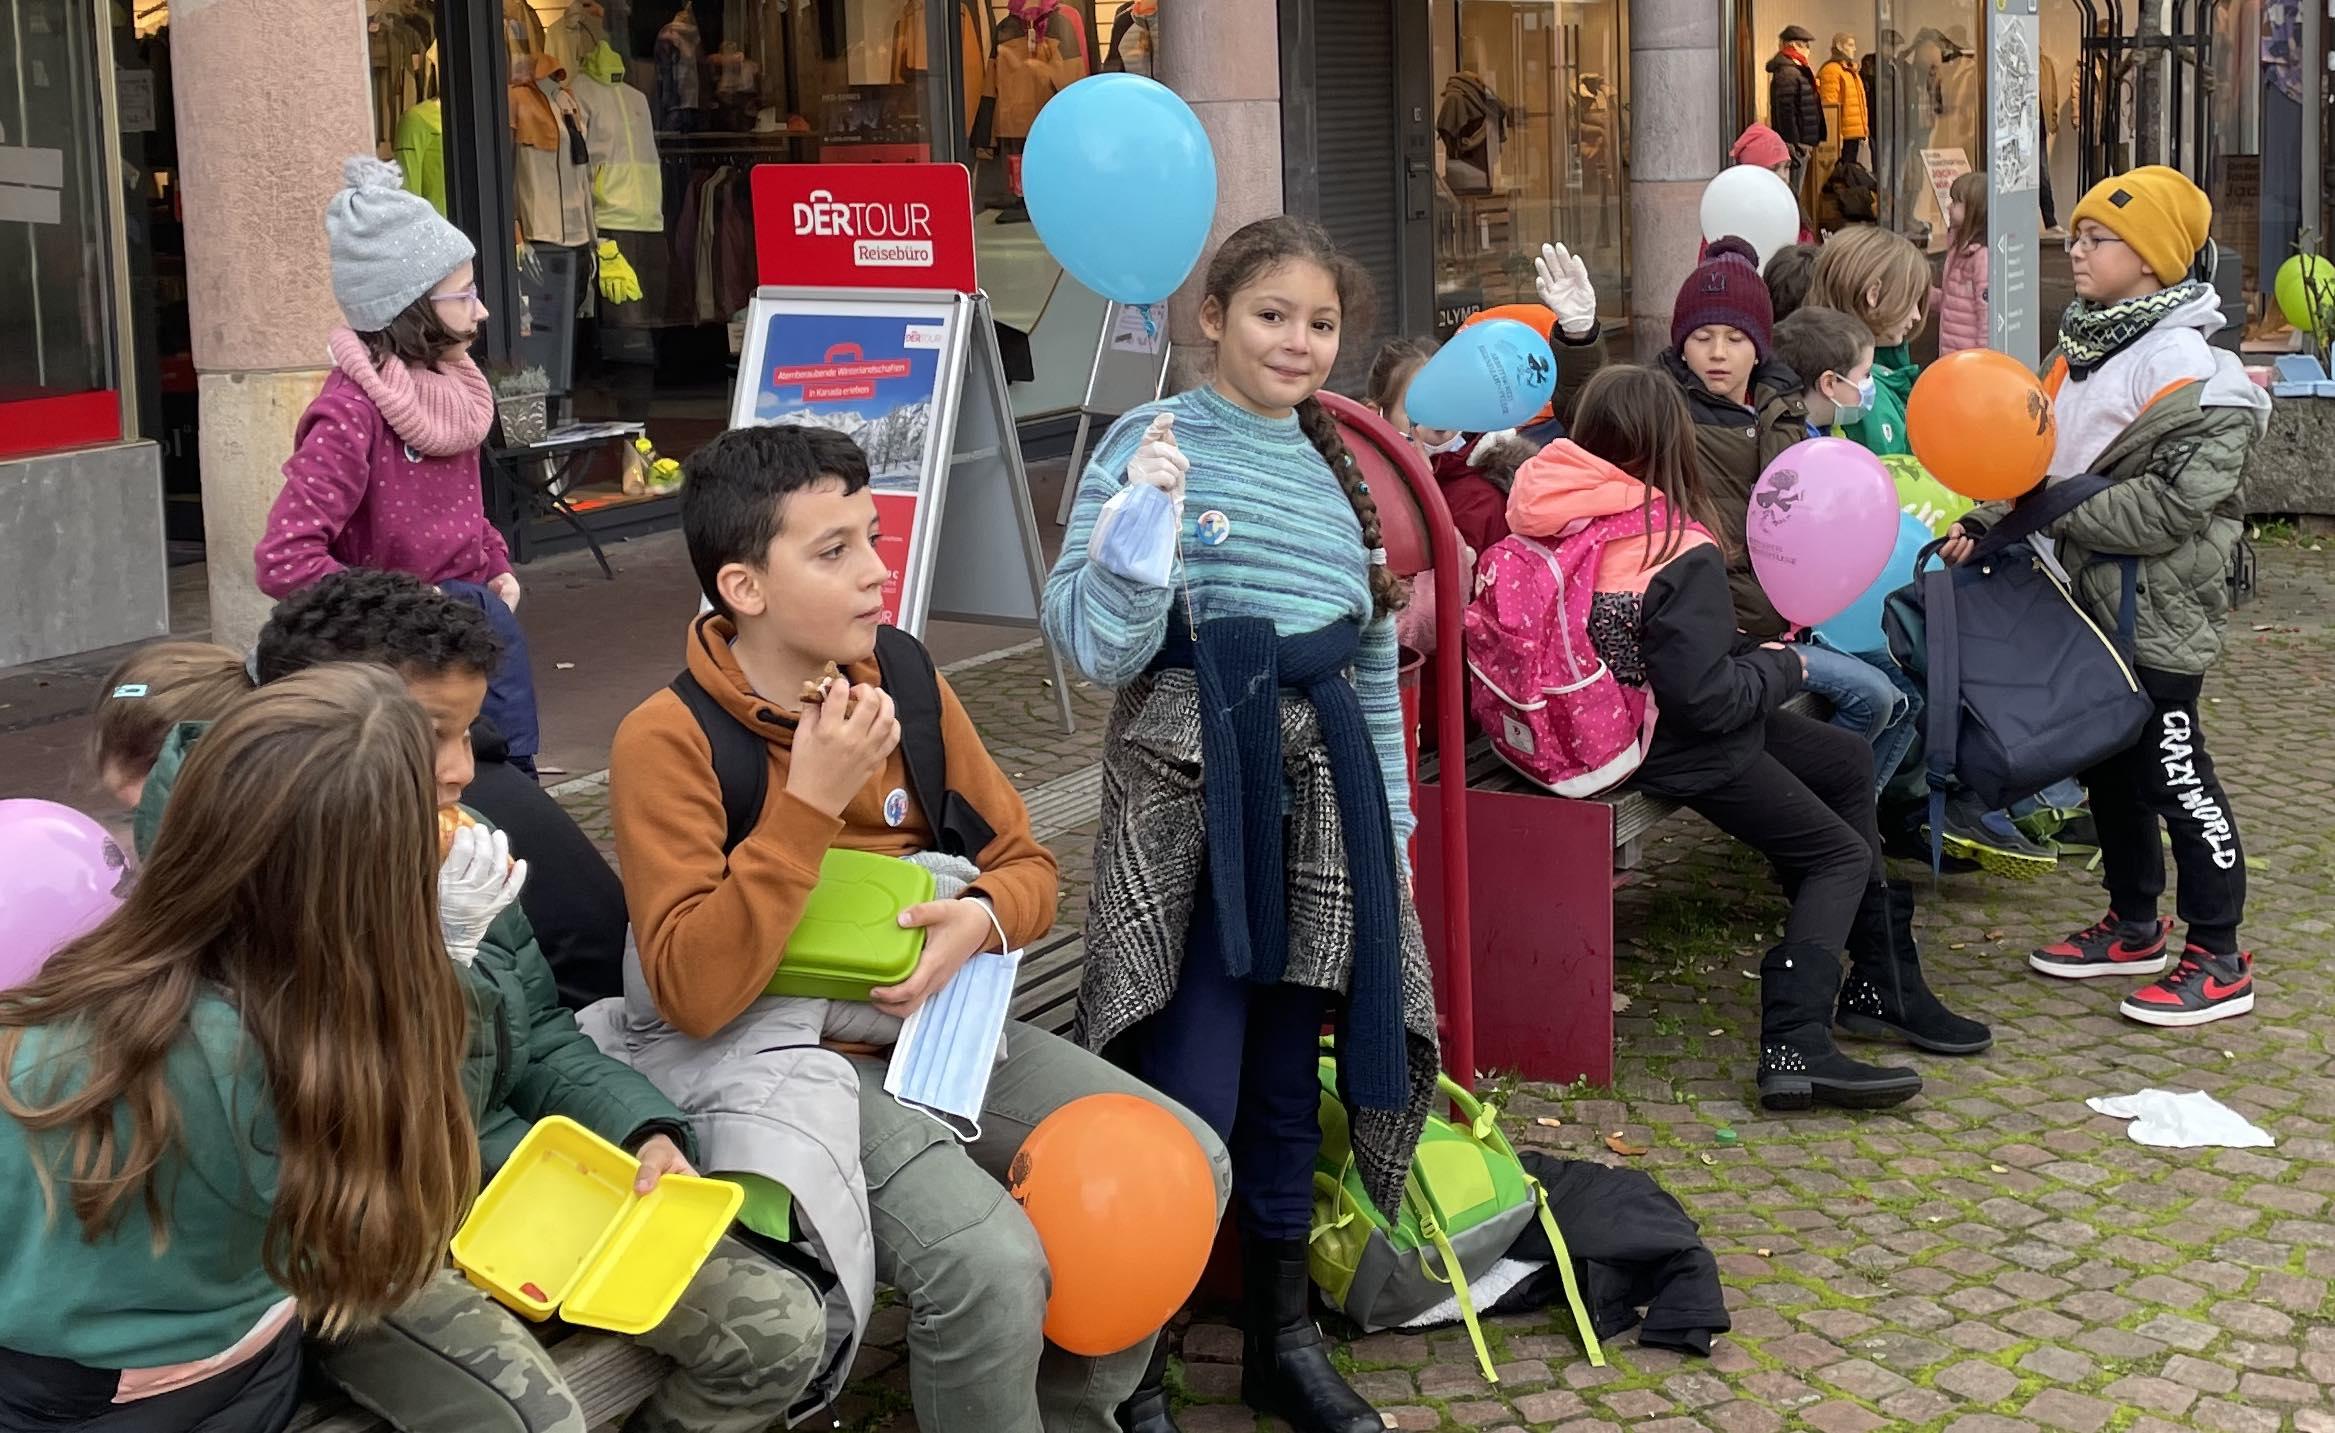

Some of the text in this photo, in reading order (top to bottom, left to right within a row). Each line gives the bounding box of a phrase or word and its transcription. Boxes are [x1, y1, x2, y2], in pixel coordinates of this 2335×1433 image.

[793, 200, 932, 237] DERTOUR
[858, 245, 929, 261] Reisebüro
[838, 363, 905, 376] Winterlandschaften
[2160, 710, 2237, 870] CRAZY WORLD
